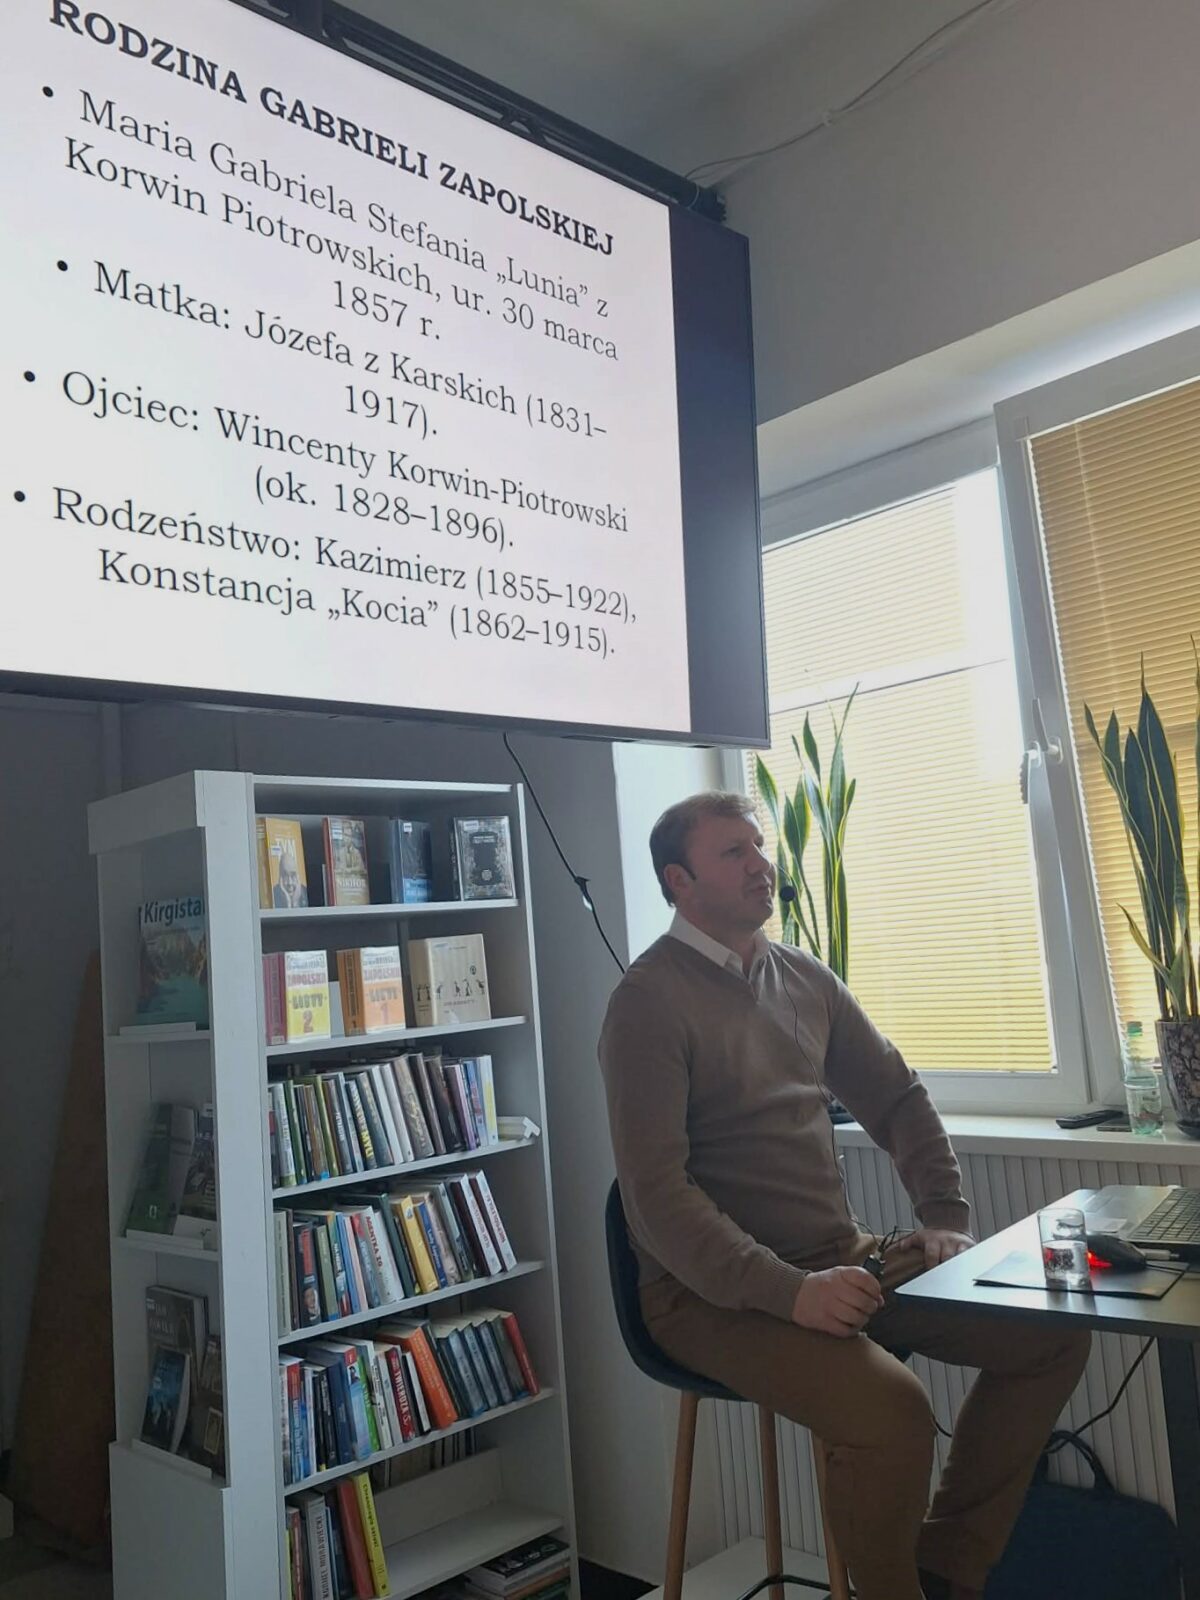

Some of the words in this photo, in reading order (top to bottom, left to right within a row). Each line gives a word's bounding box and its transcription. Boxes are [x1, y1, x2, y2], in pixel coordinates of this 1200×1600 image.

[48, 0, 248, 105] RODZINA
[259, 86, 430, 181] GABRIELI
[438, 161, 614, 256] ZAPOLSKIEJ
[64, 135, 209, 217] Korwin
[220, 192, 441, 303] Piotrowskich,
[450, 283, 491, 316] ur.
[502, 296, 535, 331] 30
[542, 318, 619, 361] marca
[78, 88, 197, 163] Maria
[209, 141, 358, 224] Gabriela
[367, 202, 488, 273] Stefania
[596, 298, 609, 318] z
[93, 259, 230, 330] Matka:
[244, 309, 355, 368] Józefa
[363, 351, 380, 375] z
[390, 351, 518, 416] Karskich
[333, 279, 408, 328] 1857
[419, 316, 440, 341] r.
[62, 370, 199, 432] Ojciec:
[213, 406, 378, 480] Wincenty
[387, 449, 629, 533] Korwin-Piotrowski
[344, 384, 438, 441] 1917).
[52, 486, 300, 561] Rodzeństwo:
[314, 535, 467, 590] Kazimierz
[255, 464, 317, 507] (ok.
[97, 547, 317, 616] Konstancja
